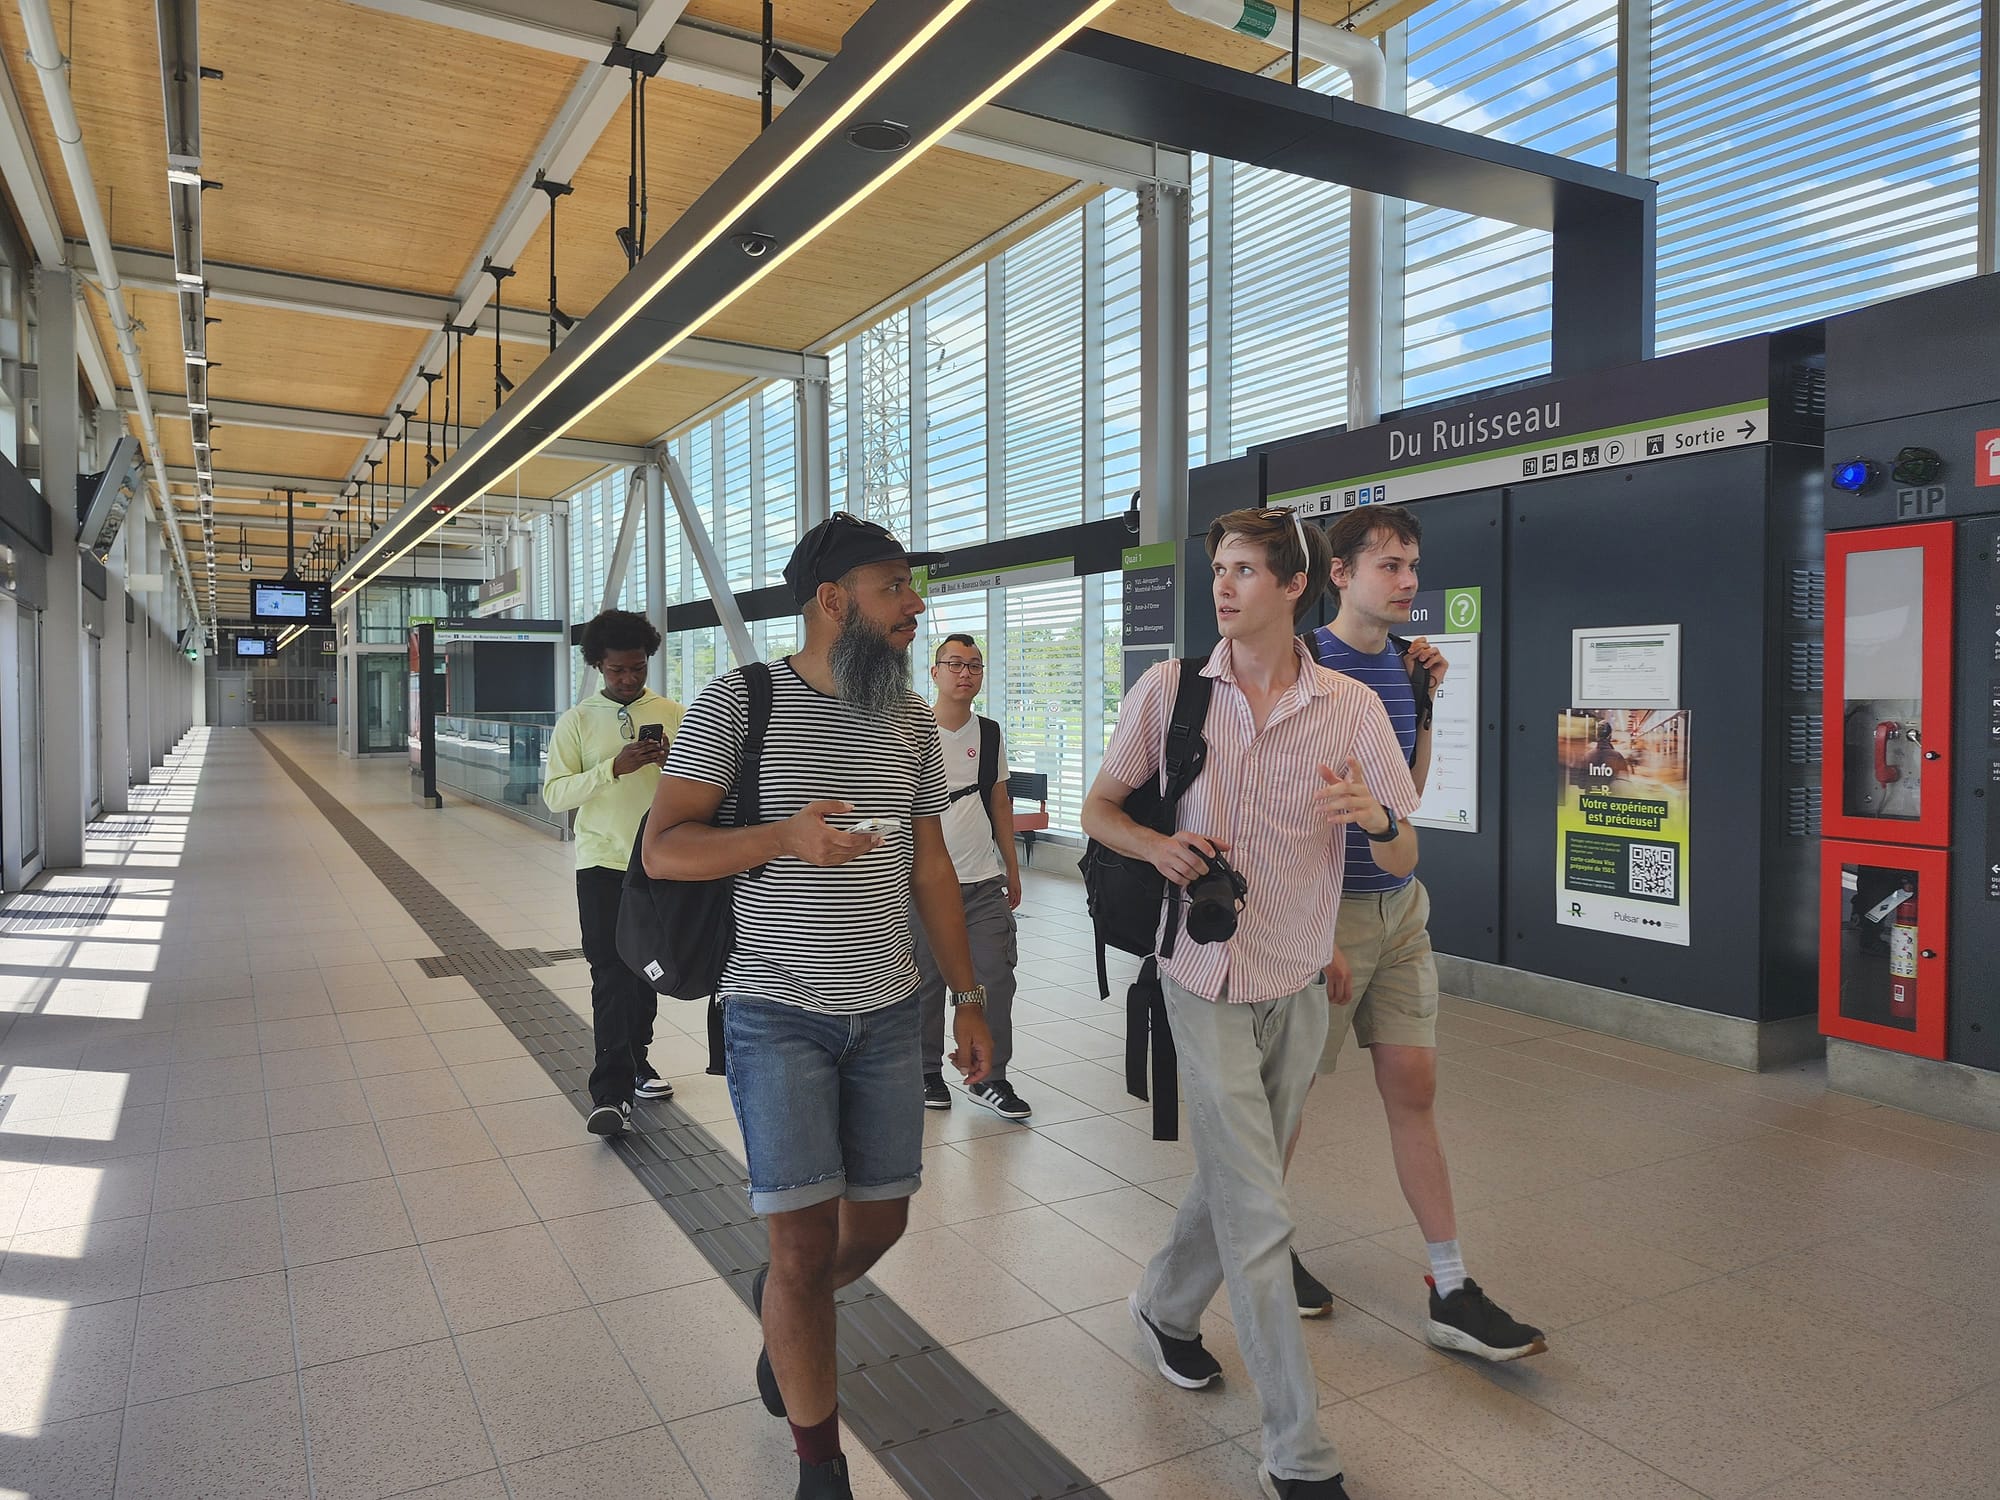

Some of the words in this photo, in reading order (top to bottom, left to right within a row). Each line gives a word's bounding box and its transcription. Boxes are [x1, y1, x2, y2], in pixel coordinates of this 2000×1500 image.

[1389, 430, 1422, 461] Du
[1433, 402, 1561, 452] Ruisseau
[1675, 427, 1725, 449] Sortie
[1651, 443, 1660, 453] A
[1899, 487, 1945, 517] FIP
[1124, 554, 1138, 565] Quai
[1589, 763, 1613, 777] Info
[1582, 798, 1608, 810] Votre
[1610, 800, 1665, 815] expérience
[1588, 812, 1603, 823] est
[1605, 812, 1657, 828] précieuse!
[1614, 911, 1640, 924] Pulsar
